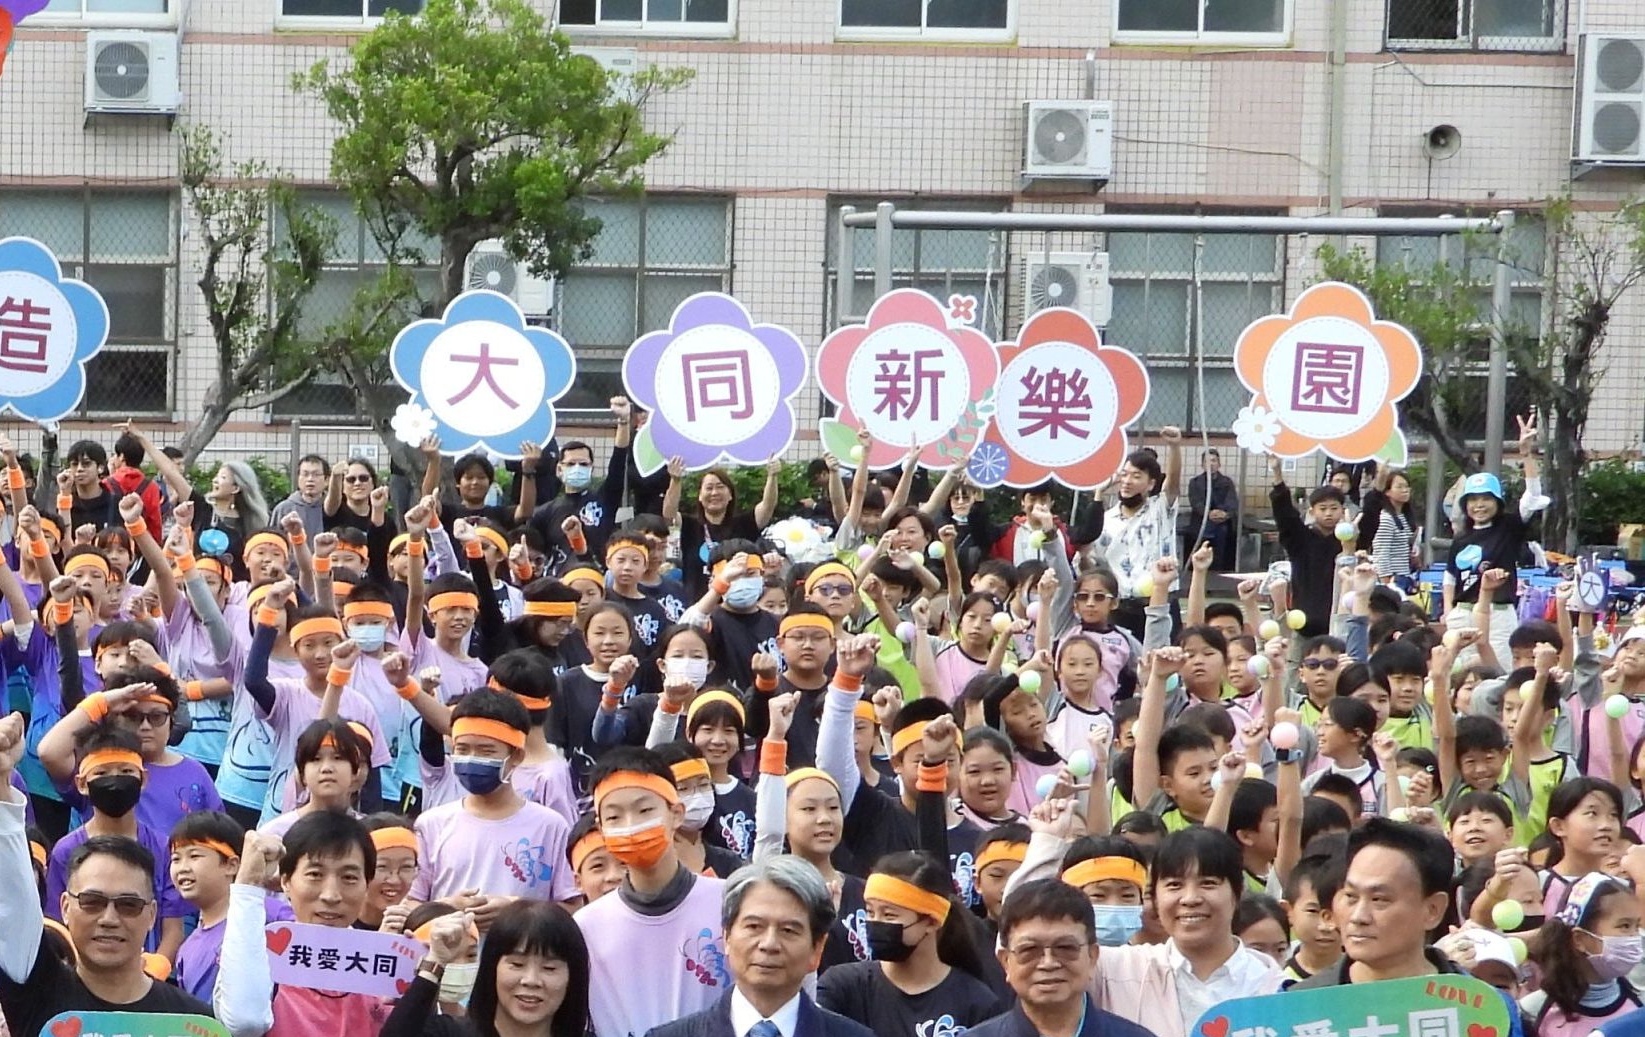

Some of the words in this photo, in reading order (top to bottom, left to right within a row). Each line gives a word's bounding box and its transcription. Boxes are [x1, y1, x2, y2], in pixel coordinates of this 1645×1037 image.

[448, 343, 520, 411] 大
[681, 350, 754, 421] 同
[874, 348, 946, 421] 新
[1018, 366, 1093, 440] 樂
[1291, 341, 1364, 415] 園
[289, 945, 397, 977] 我愛大同
